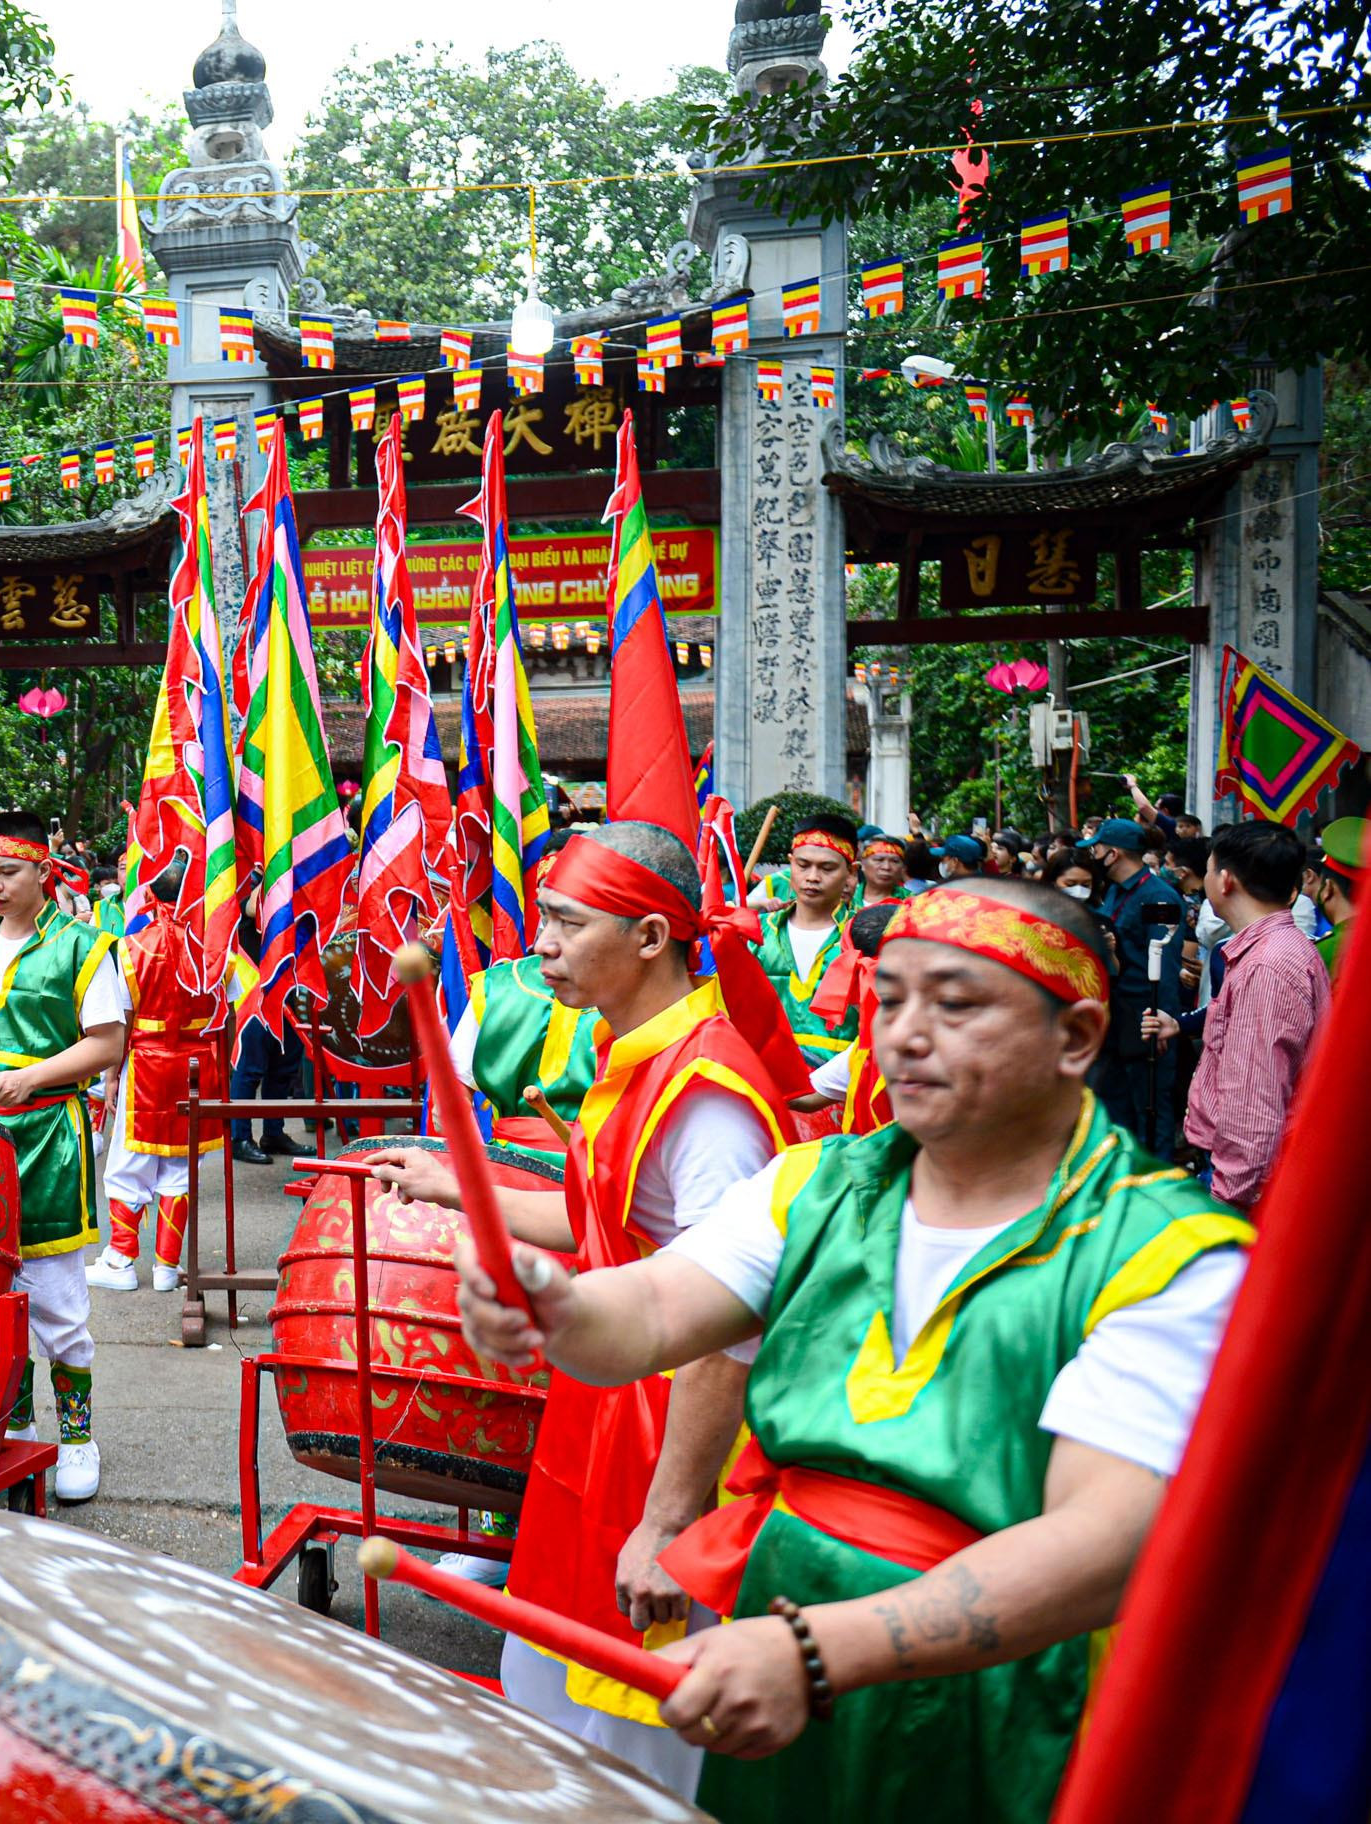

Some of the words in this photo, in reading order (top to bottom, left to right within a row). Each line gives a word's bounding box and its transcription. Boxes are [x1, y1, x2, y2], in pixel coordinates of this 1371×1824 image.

[304, 558, 338, 580] NHIỆT
[340, 557, 365, 579] LIỆT
[439, 552, 464, 572] CÁC
[563, 547, 580, 566] VÀ
[669, 541, 690, 562] DỰ
[330, 583, 369, 618] HỘI
[559, 569, 609, 604] CHÙ
